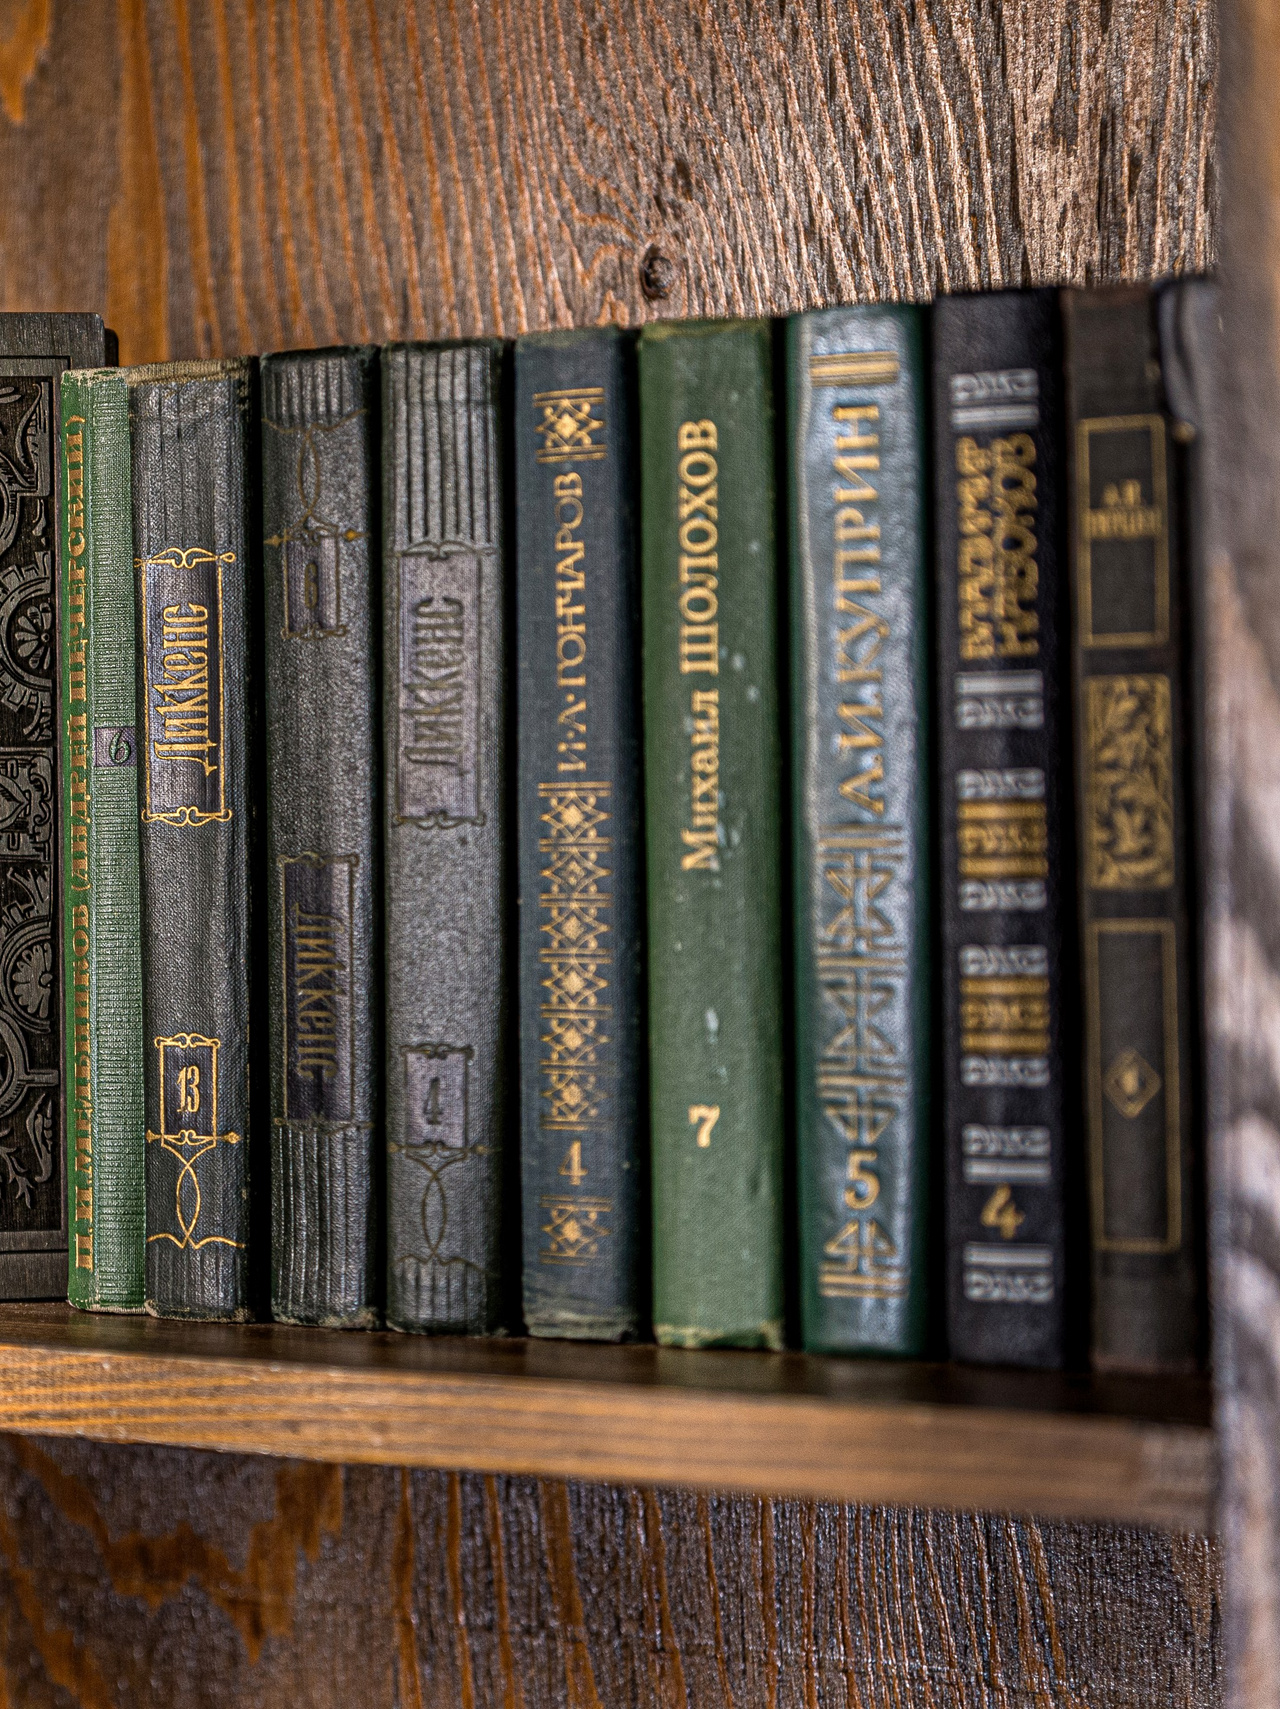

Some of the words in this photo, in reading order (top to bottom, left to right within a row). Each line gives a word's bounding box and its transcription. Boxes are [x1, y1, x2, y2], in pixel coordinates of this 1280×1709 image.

[64, 414, 90, 704] ПЕЧЕРСКИЙ)
[677, 419, 719, 675] ШОЛОХОВ
[153, 602, 217, 774] Диккенс
[108, 729, 130, 764] 6
[67, 713, 93, 891] (АНДРЕЙ
[680, 689, 721, 872] Михаил
[424, 1074, 441, 1126] 4
[688, 1103, 720, 1149] 7
[558, 1141, 587, 1187] 4
[846, 1150, 879, 1210] 5
[981, 1185, 1023, 1239] 4
